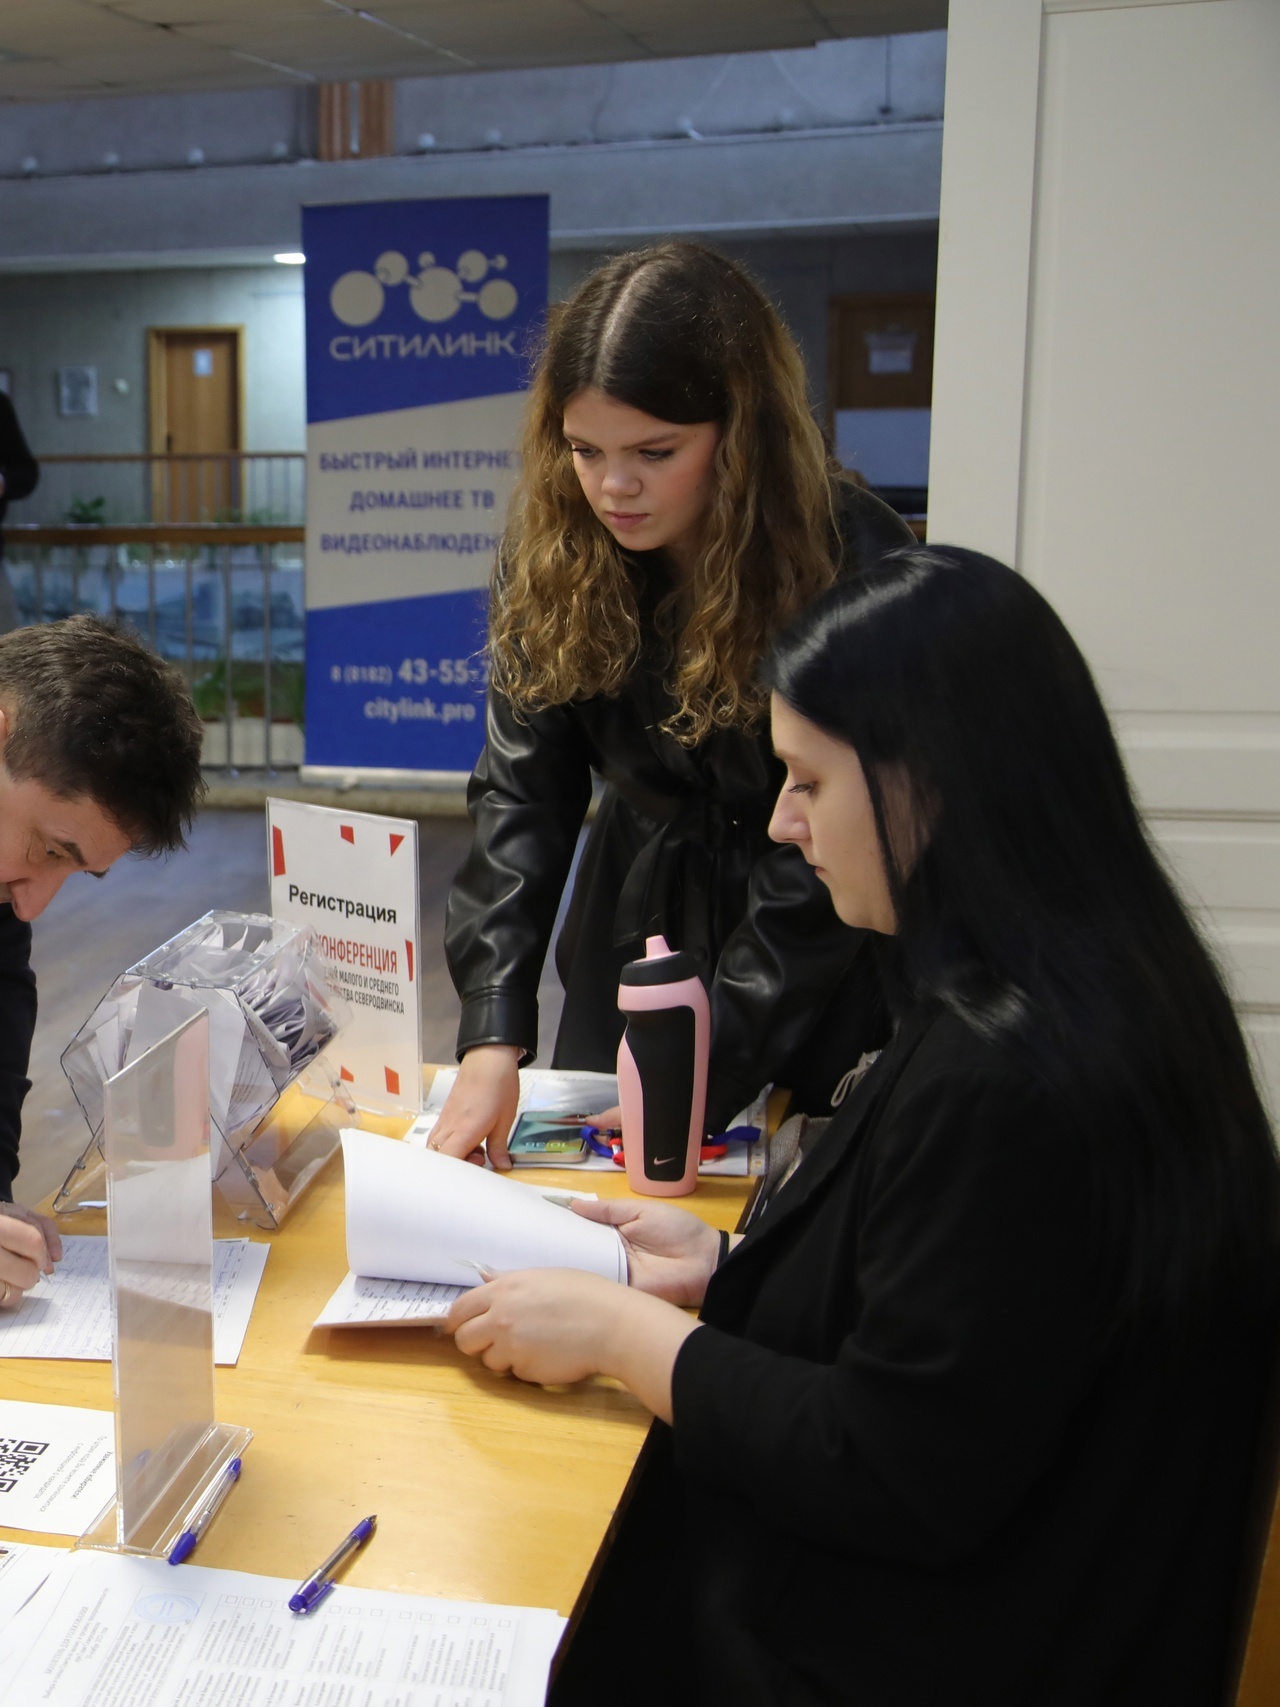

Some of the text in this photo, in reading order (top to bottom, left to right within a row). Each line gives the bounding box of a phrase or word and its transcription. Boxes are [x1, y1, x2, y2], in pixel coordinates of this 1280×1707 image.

[329, 331, 517, 361] СИТИЛИНК
[319, 447, 417, 471] БЫСТРЫЙ
[349, 489, 495, 513] ДОМАШНЕЕ ТВ
[321, 532, 499, 554] ВИДЕОНАБЛЮДЕН
[398, 658, 490, 685] 43-55-
[364, 698, 476, 724] citylink.pro
[289, 884, 397, 924] Регистрация
[339, 970, 363, 988] МАЛОГО
[363, 976, 369, 989] И
[369, 978, 400, 997] СРЕДНЕГО
[354, 991, 405, 1015] СЕВЕРОДВИНСКА
